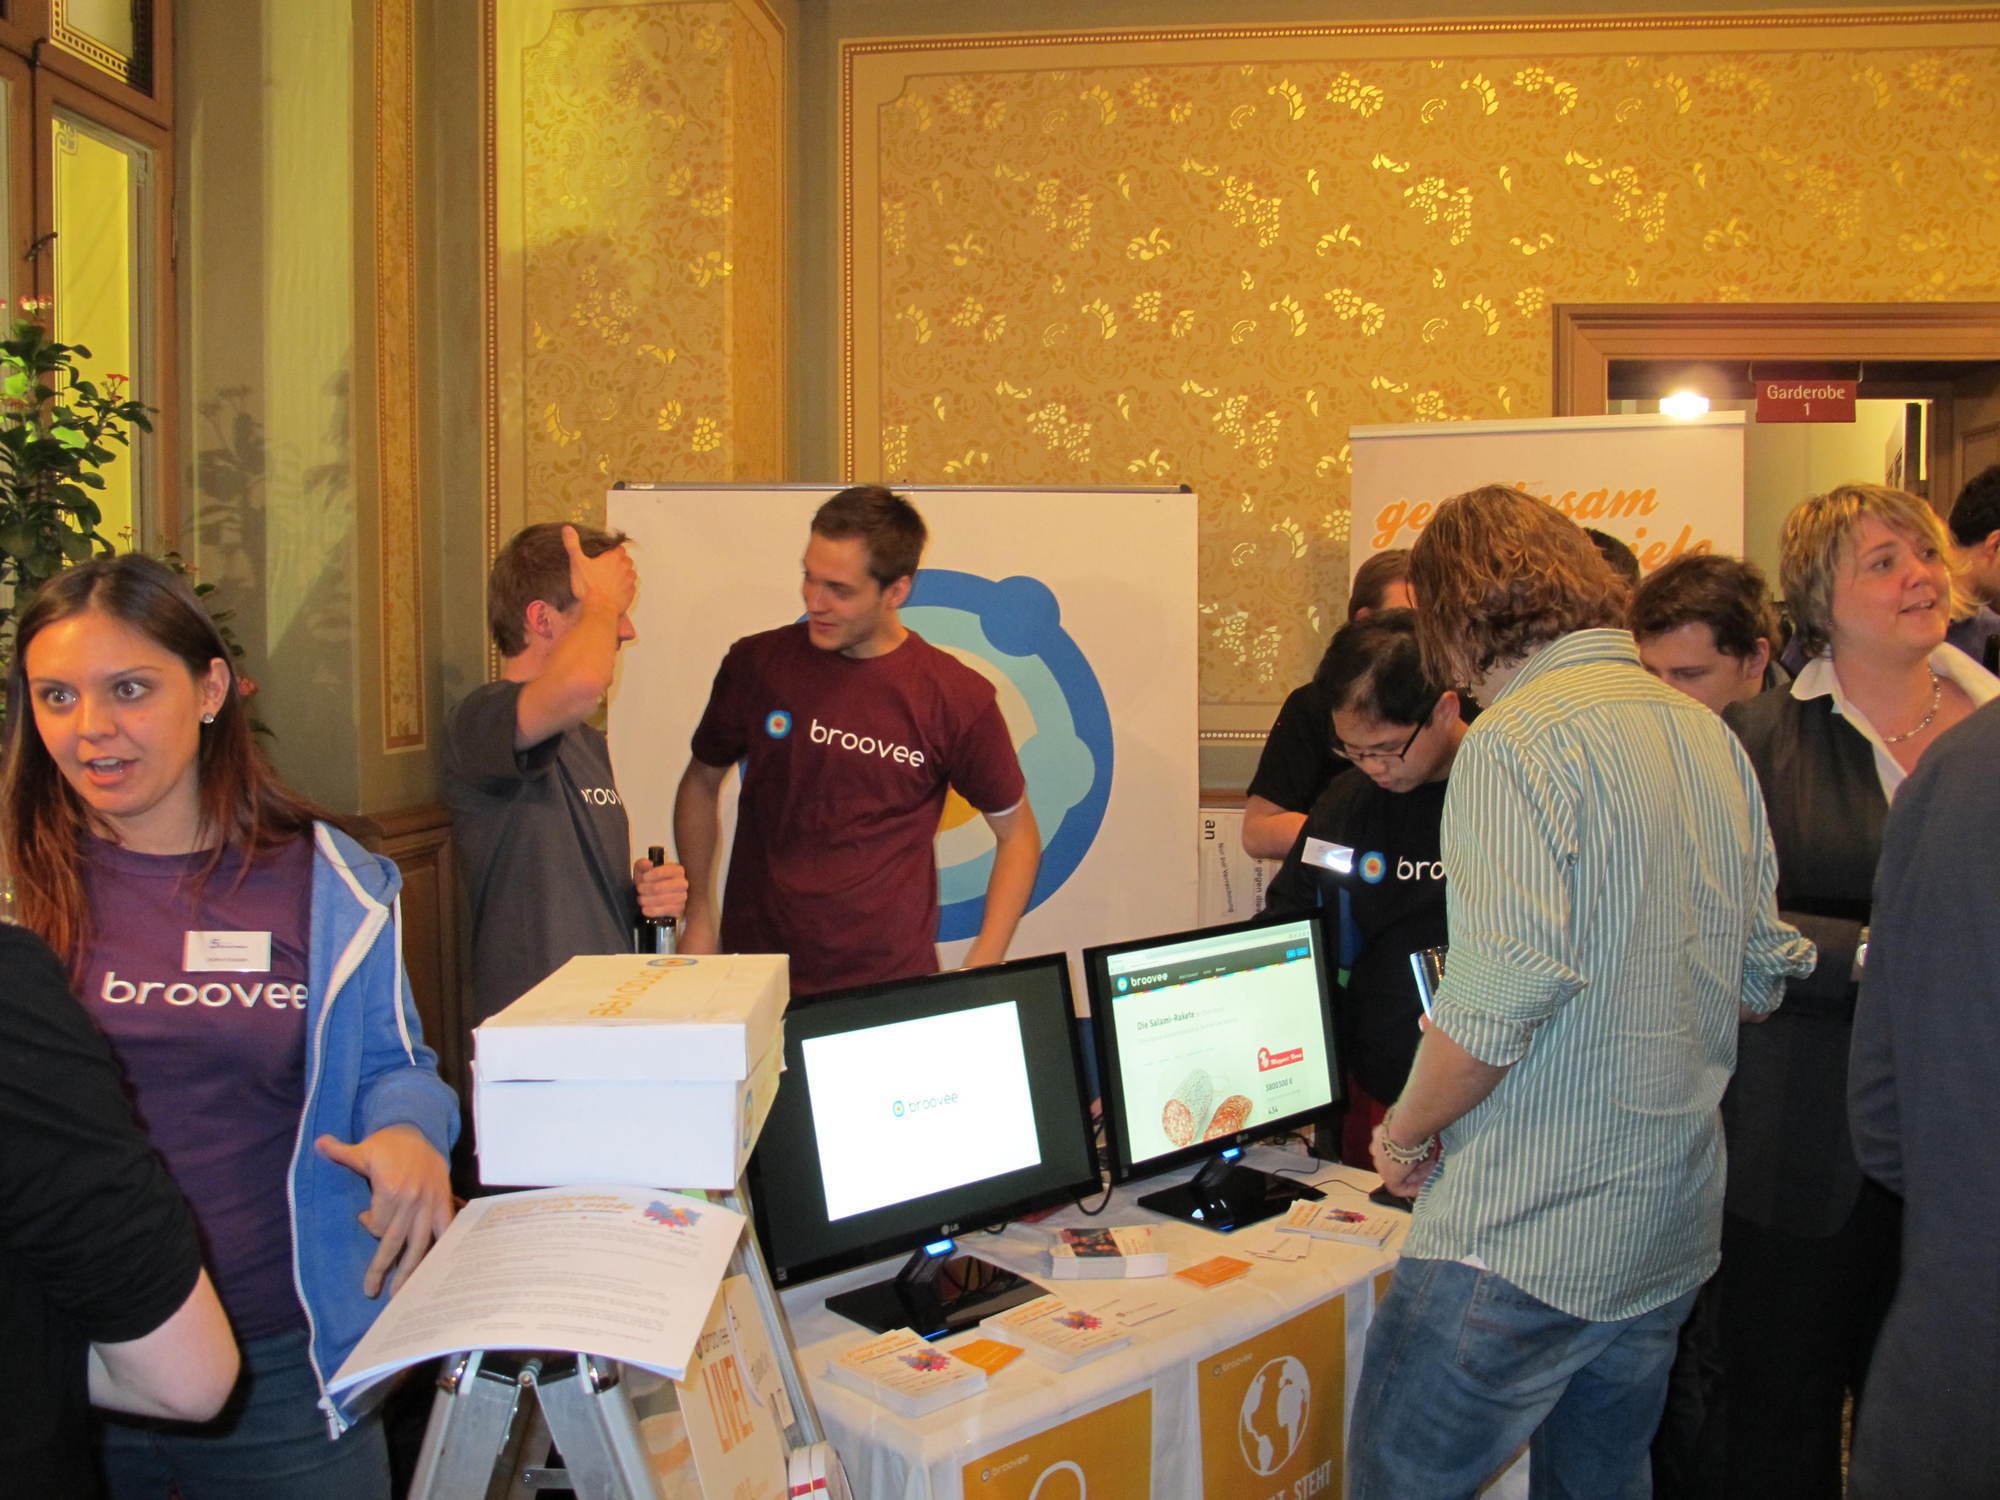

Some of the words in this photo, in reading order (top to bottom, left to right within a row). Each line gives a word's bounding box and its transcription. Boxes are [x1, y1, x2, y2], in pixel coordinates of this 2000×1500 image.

[1767, 384, 1846, 400] Garderobe
[1803, 402, 1811, 416] 1
[810, 718, 925, 767] broovee
[1204, 820, 1216, 840] an
[1130, 971, 1169, 987] broovee
[101, 971, 309, 1009] broovee
[908, 1092, 960, 1113] broovee
